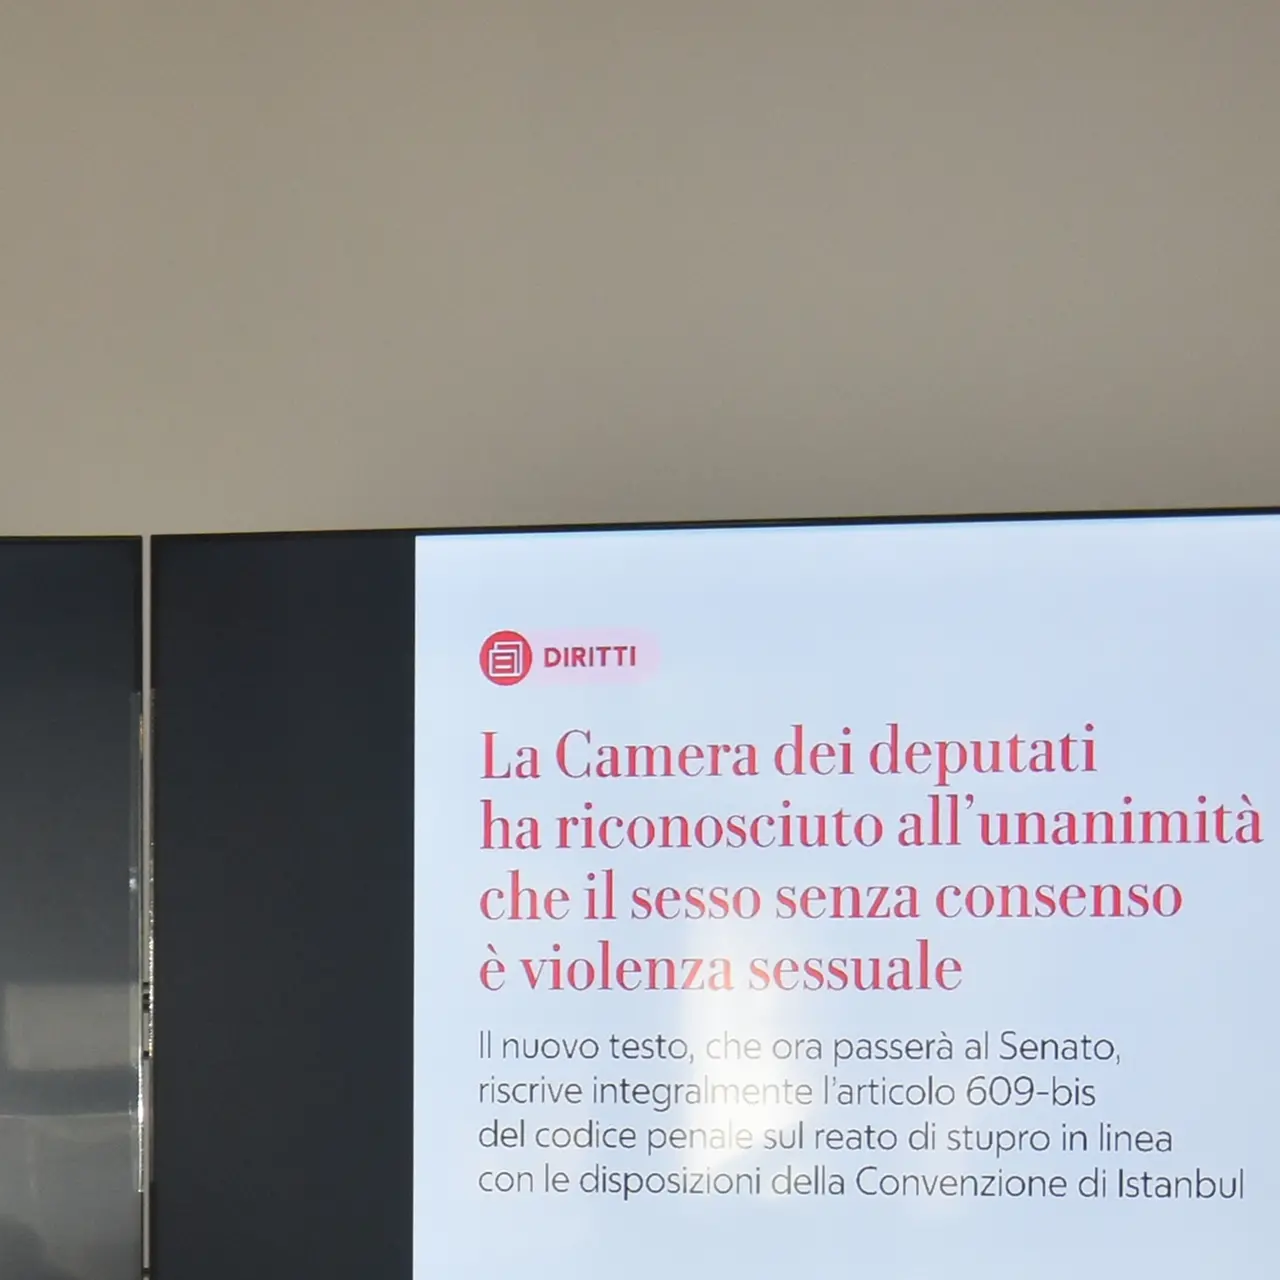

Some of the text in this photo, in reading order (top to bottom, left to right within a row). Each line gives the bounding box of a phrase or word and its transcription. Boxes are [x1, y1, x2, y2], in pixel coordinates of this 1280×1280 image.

[543, 645, 637, 668] DIRITTI
[480, 722, 1098, 787] La Camera dei deputati
[480, 798, 542, 850] ha
[555, 799, 884, 850] riconosciuto
[479, 868, 1183, 921] che il sesso senza consenso
[479, 938, 962, 992] è violenza sessuale
[479, 1029, 1120, 1068] Il nuovo testo, che ora passerà al Senato,
[479, 1075, 583, 1105] riscrive
[593, 1075, 813, 1113] integralmente
[966, 1075, 1096, 1107] 609-bis
[478, 1117, 1172, 1159] del codice penale sul reato di stupro in linea
[478, 1162, 1244, 1201] con le disposizioni della Convenzione di Istanbul
